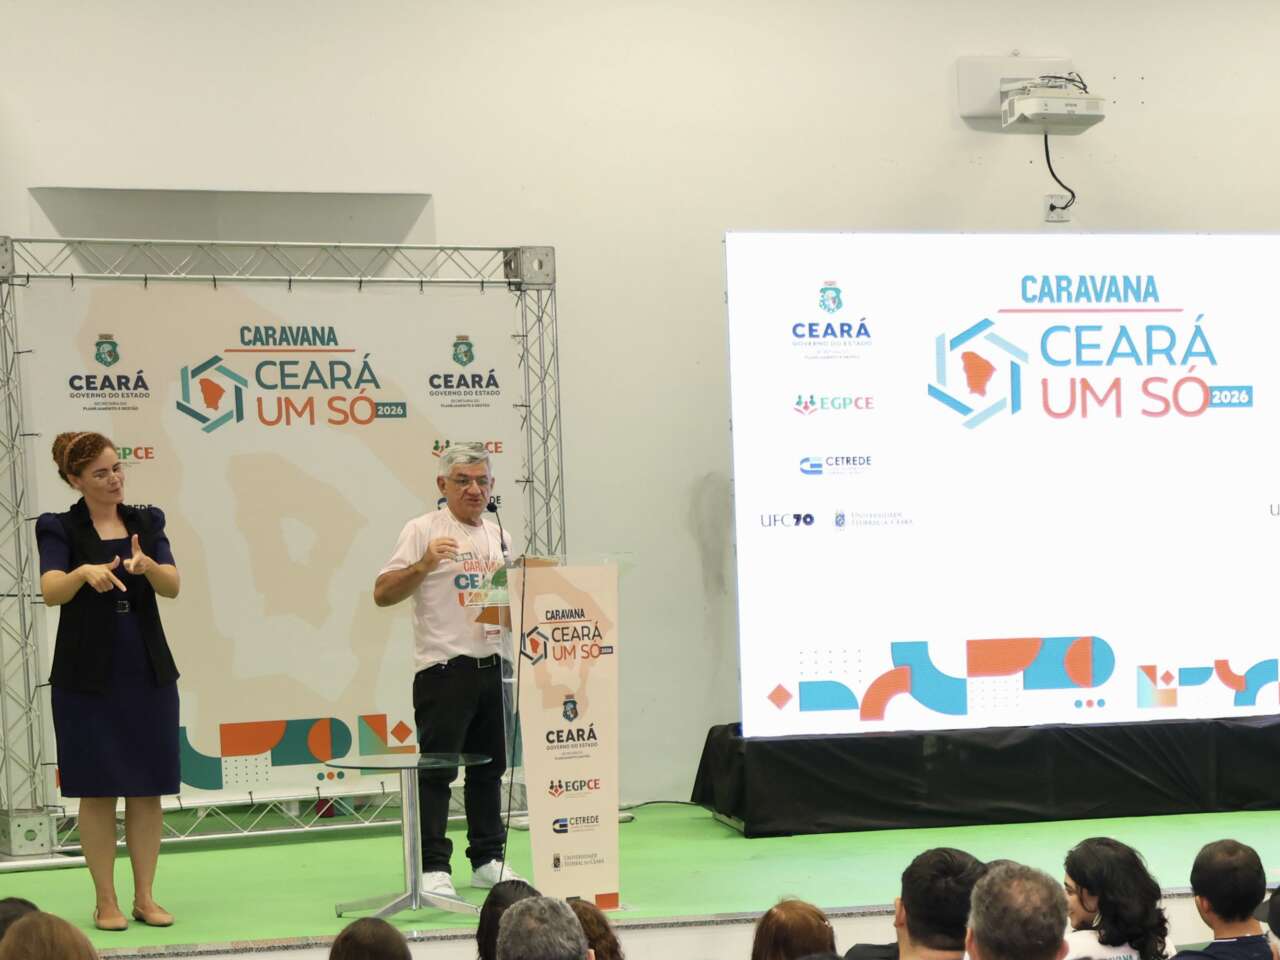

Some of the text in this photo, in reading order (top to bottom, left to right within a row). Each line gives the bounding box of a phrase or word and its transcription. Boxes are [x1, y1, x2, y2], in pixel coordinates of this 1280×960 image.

[1021, 275, 1160, 303] CARAVANA
[240, 326, 338, 346] CARAVANA
[792, 317, 872, 339] CEARÁ
[1040, 314, 1218, 367] CEARÁ
[69, 370, 149, 391] CEARÁ
[255, 353, 381, 390] CEARÁ
[429, 368, 499, 389] CEARÁ
[1041, 365, 1249, 419] UM SÓ 2026
[256, 388, 403, 426] UM SÓ 2026
[820, 396, 875, 410] EGPCE
[825, 456, 872, 466] CETREDE
[545, 608, 585, 621] CARAVANA
[552, 621, 603, 643] CEARÁ
[552, 645, 577, 661] UM
[581, 640, 601, 659] SÓ
[546, 722, 597, 744] CEARÁ
[565, 779, 600, 791] EGPCE
[569, 815, 600, 826] CETREDE
